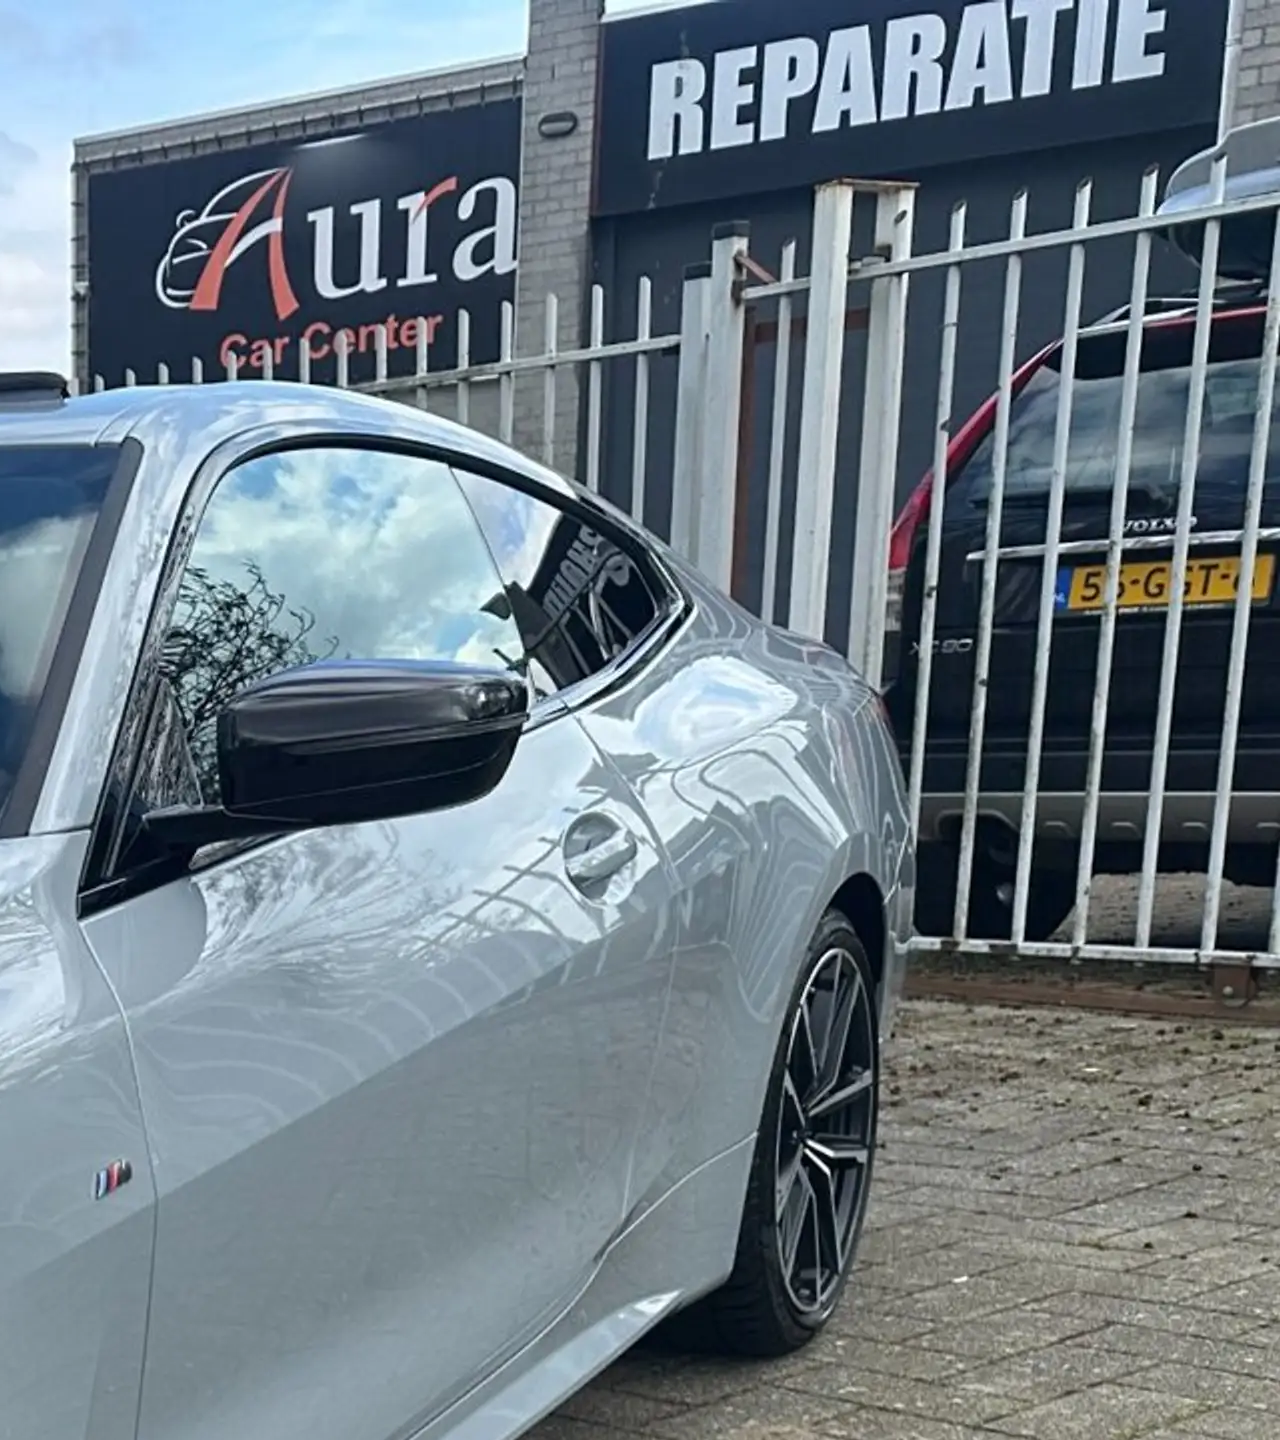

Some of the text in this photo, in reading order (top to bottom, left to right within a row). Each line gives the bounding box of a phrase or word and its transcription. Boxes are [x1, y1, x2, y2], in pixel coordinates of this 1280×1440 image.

[647, 0, 1167, 161] REPARATIE
[188, 166, 520, 321] Aura
[220, 333, 290, 369] Car
